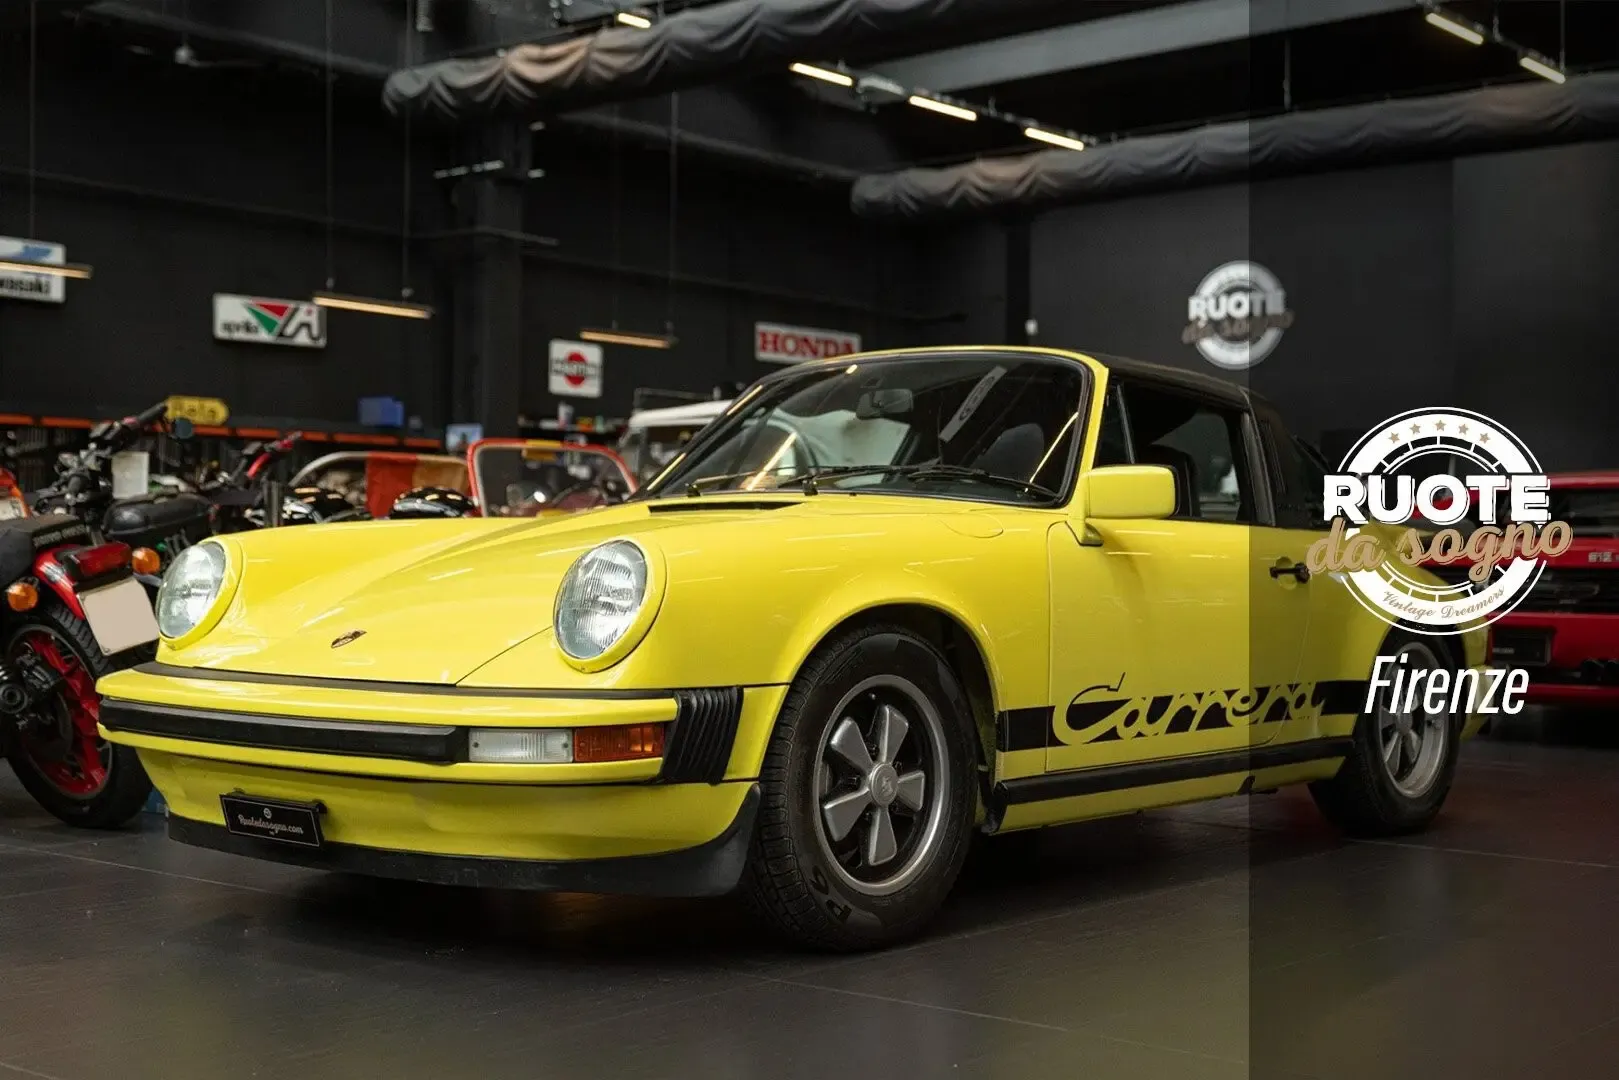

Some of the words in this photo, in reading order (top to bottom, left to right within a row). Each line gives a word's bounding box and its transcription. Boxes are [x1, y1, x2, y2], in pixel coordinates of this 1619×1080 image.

[1187, 288, 1286, 320] RUOTE
[758, 333, 854, 358] HONDA
[1053, 672, 1327, 744] Carrera
